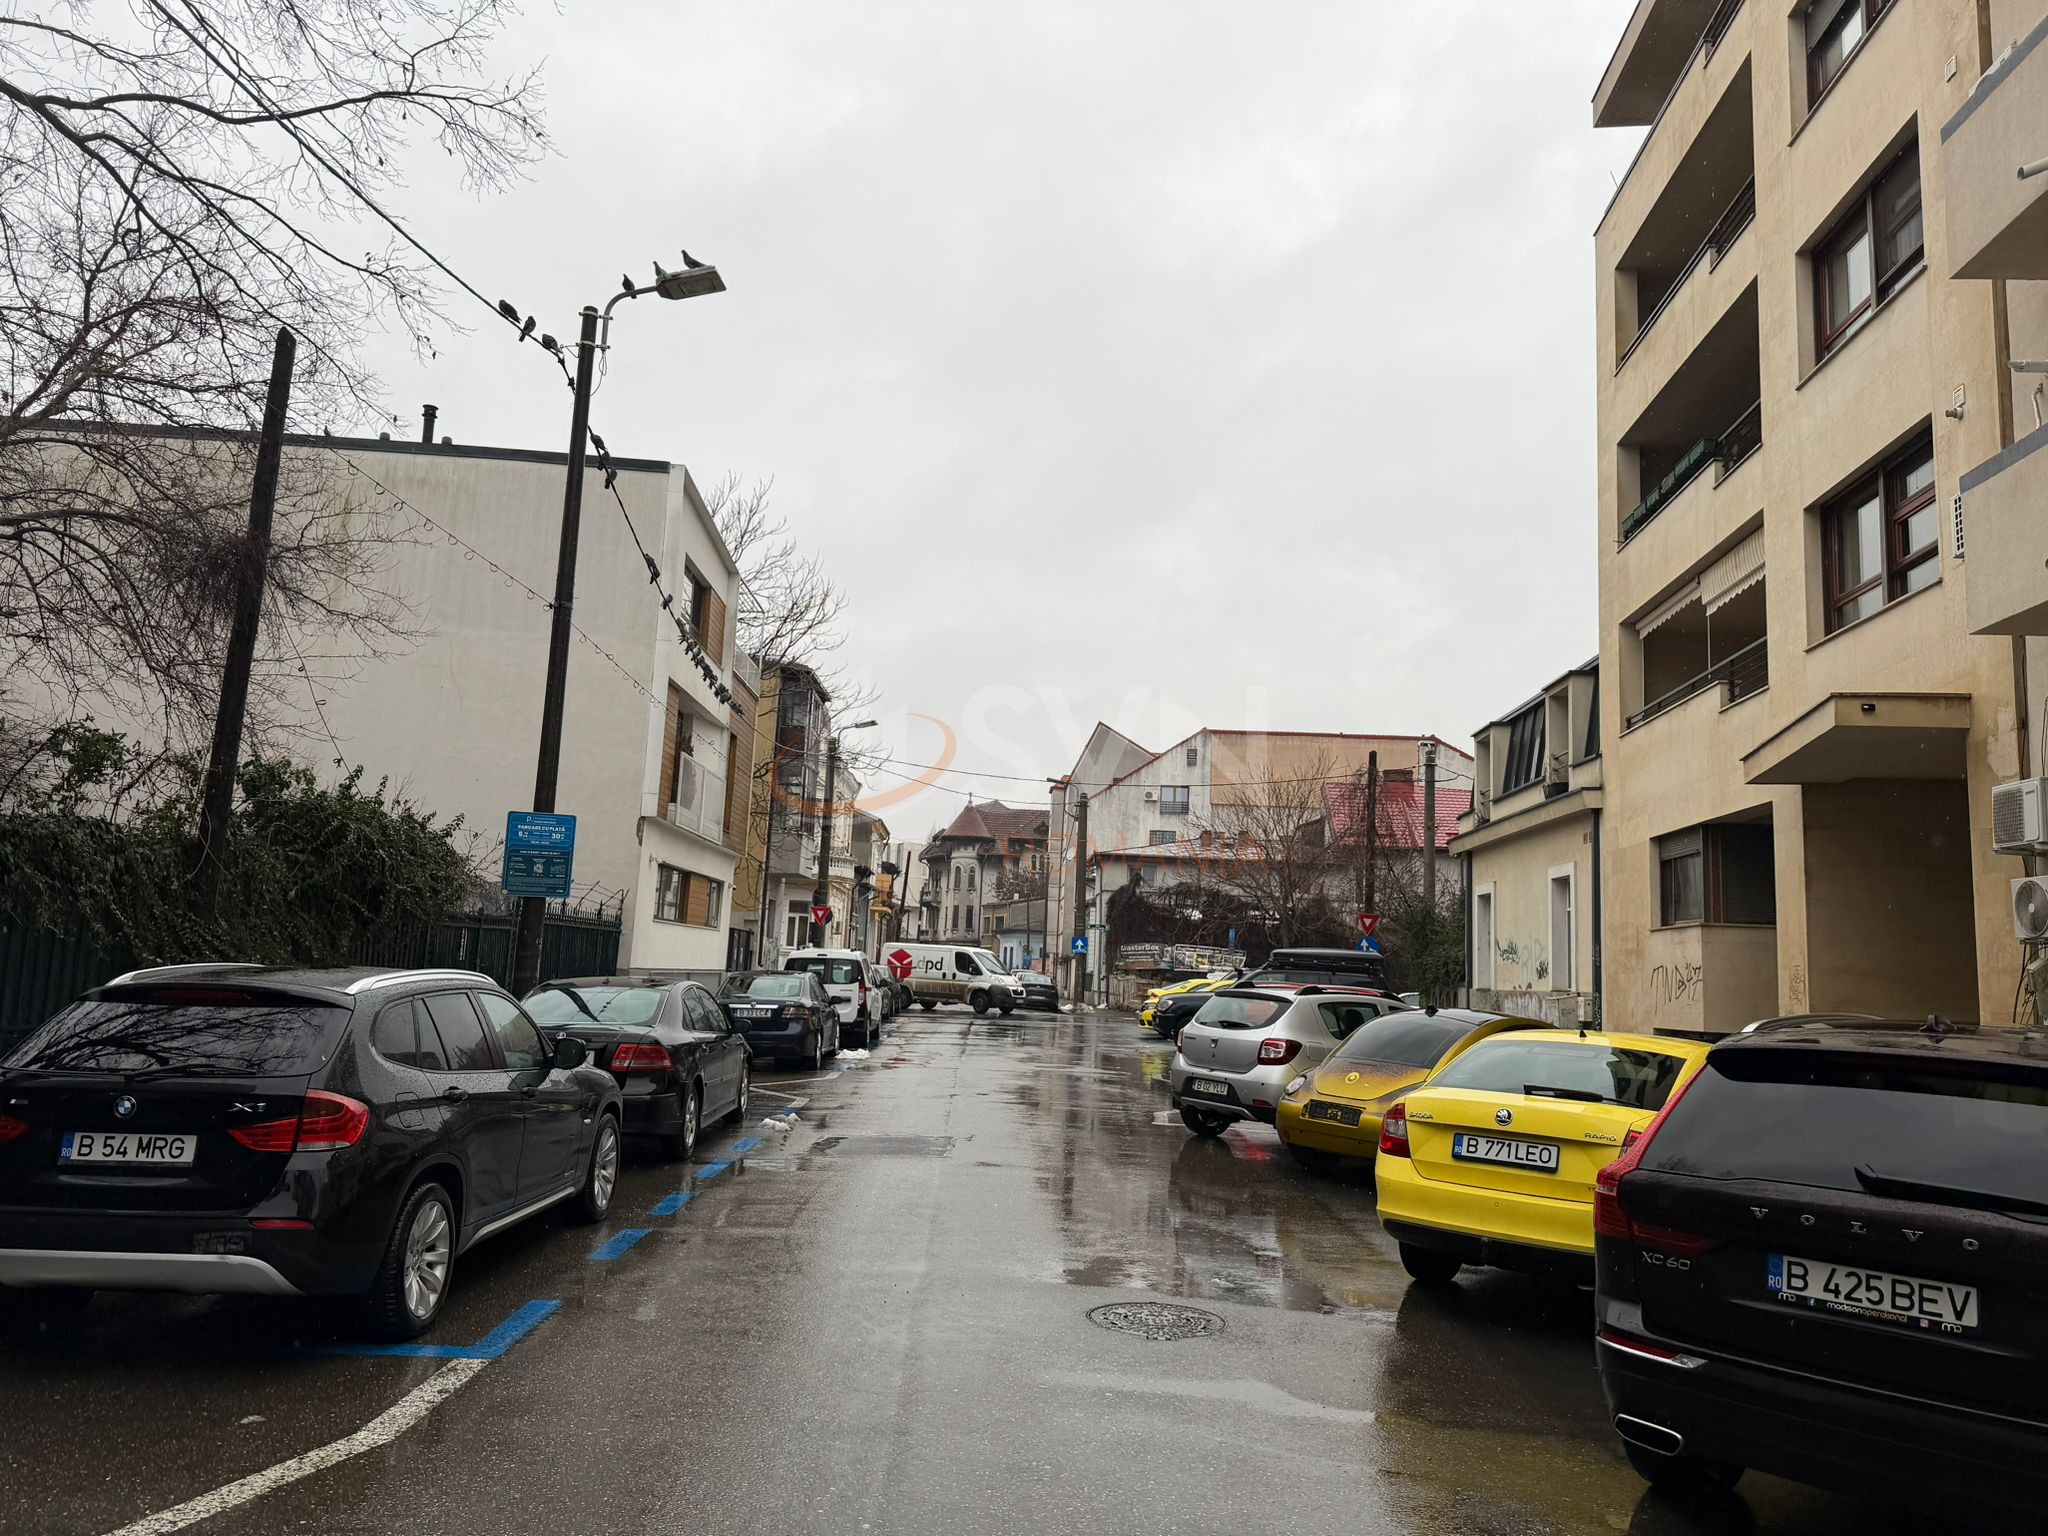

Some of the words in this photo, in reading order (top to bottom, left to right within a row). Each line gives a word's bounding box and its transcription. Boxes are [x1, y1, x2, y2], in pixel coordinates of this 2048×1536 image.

[1120, 943, 1159, 951] MasterBox
[917, 955, 944, 974] dpd
[1196, 1080, 1203, 1090] B
[1212, 1082, 1226, 1094] YLU
[226, 1102, 267, 1113] X1
[1584, 1131, 1617, 1143] RAPID
[61, 1147, 72, 1158] RO
[77, 1134, 95, 1158] B
[102, 1135, 128, 1159] 54
[135, 1136, 186, 1160] MRG
[1751, 1206, 1979, 1250] VOLVO
[1768, 1275, 1782, 1289] RO
